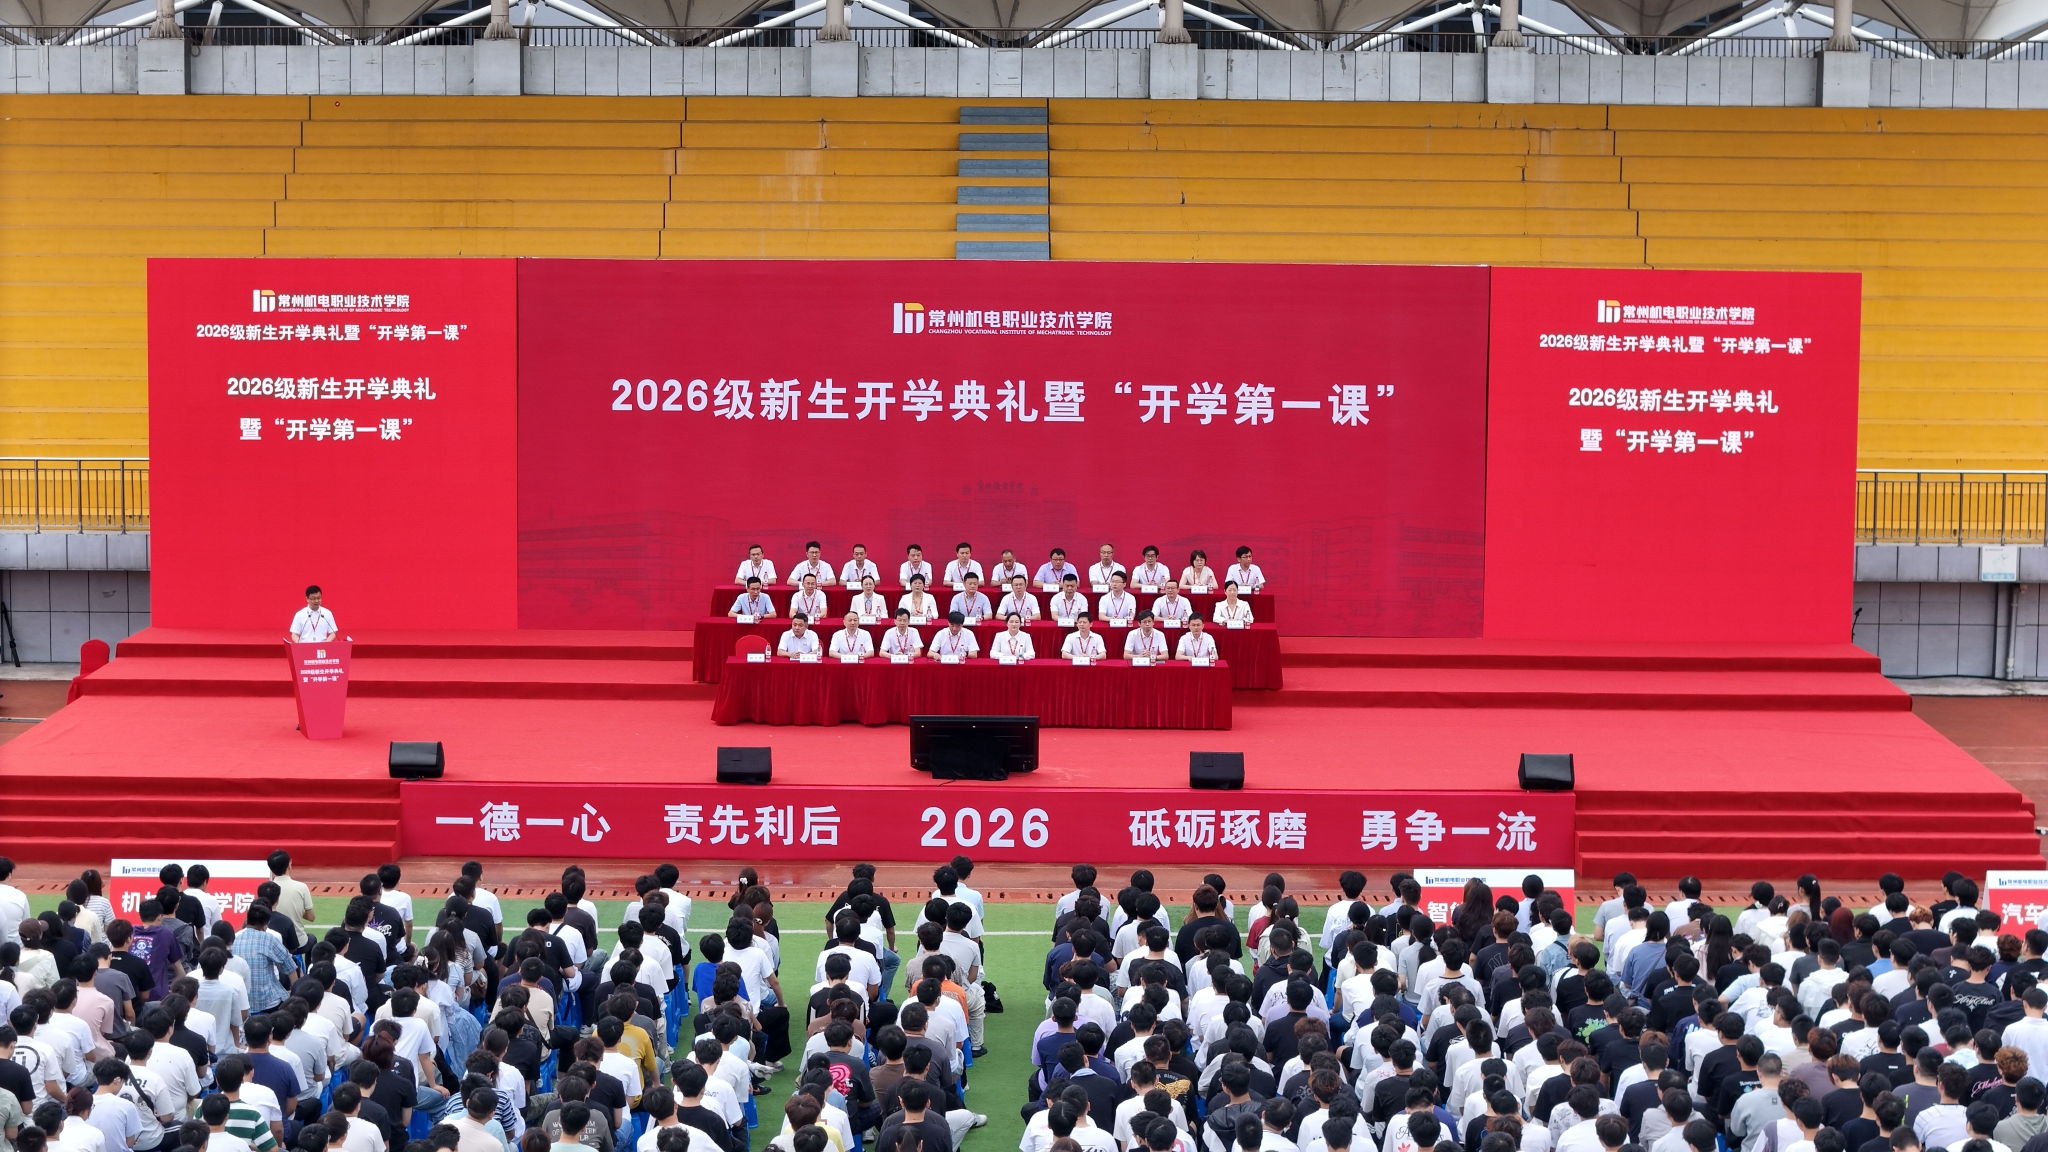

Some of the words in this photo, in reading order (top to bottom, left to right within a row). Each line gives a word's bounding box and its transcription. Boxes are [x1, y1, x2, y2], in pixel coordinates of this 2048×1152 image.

[278, 294, 410, 308] 常州机电职业技术学院
[1622, 304, 1756, 321] 常州机电职业技术学院
[928, 310, 1113, 330] 常州机电职业技术学院
[196, 324, 468, 342] 2026级新生开学典礼暨“开学第一课”
[1539, 334, 1812, 355] 2026级新生开学典礼暨“开学第一课”
[227, 377, 437, 401] 2026级新生开学典礼
[1568, 387, 1779, 414] 2026级新生开学典礼
[611, 377, 1396, 427] 2026级新生开学典礼暨“开学第一课”
[239, 417, 413, 441] 暨“开学第一课”
[1579, 428, 1755, 454] 暨“开学第一课”
[435, 801, 612, 843] 一德一心
[663, 803, 841, 846] 责先利后
[920, 806, 1049, 849] 2026
[1128, 807, 1307, 850] 砥砺琢磨
[1361, 808, 1538, 851] 勇争一流
